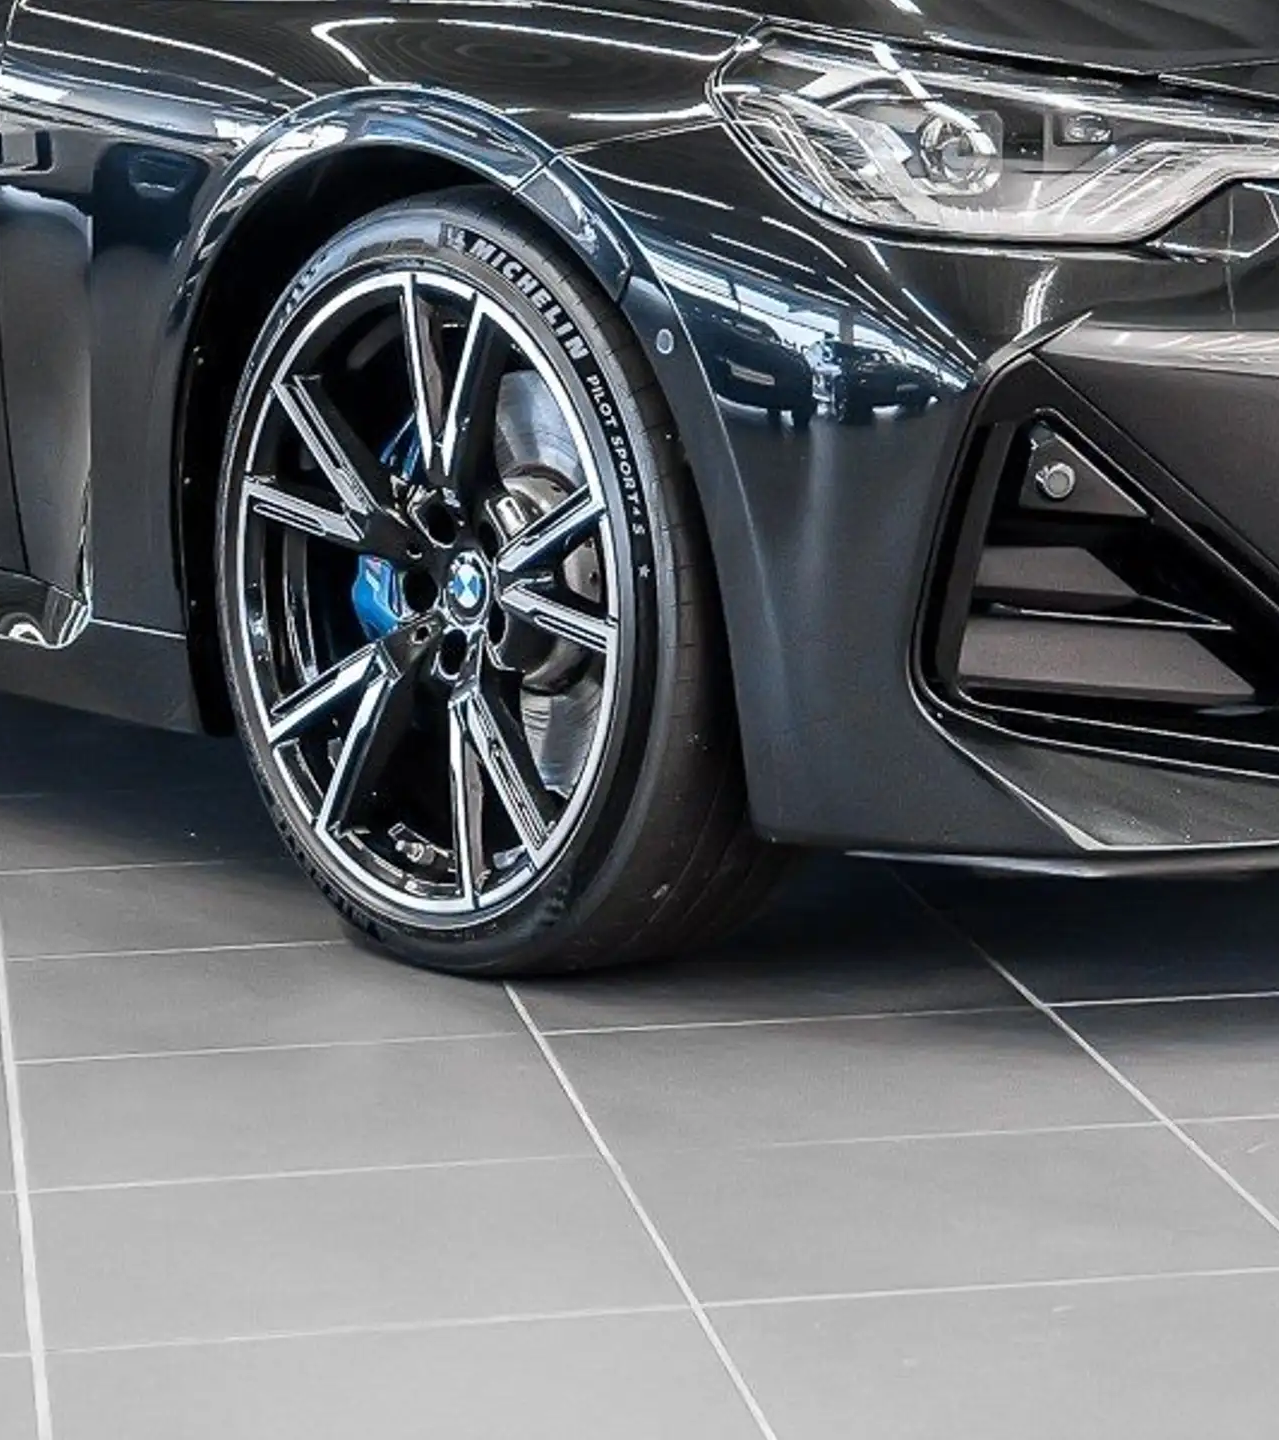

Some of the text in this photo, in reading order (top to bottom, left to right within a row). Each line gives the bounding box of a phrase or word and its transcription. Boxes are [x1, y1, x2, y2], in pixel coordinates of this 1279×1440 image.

[468, 237, 591, 361] MICHELIN
[586, 374, 618, 428] PILOT
[610, 435, 641, 504] SPORT
